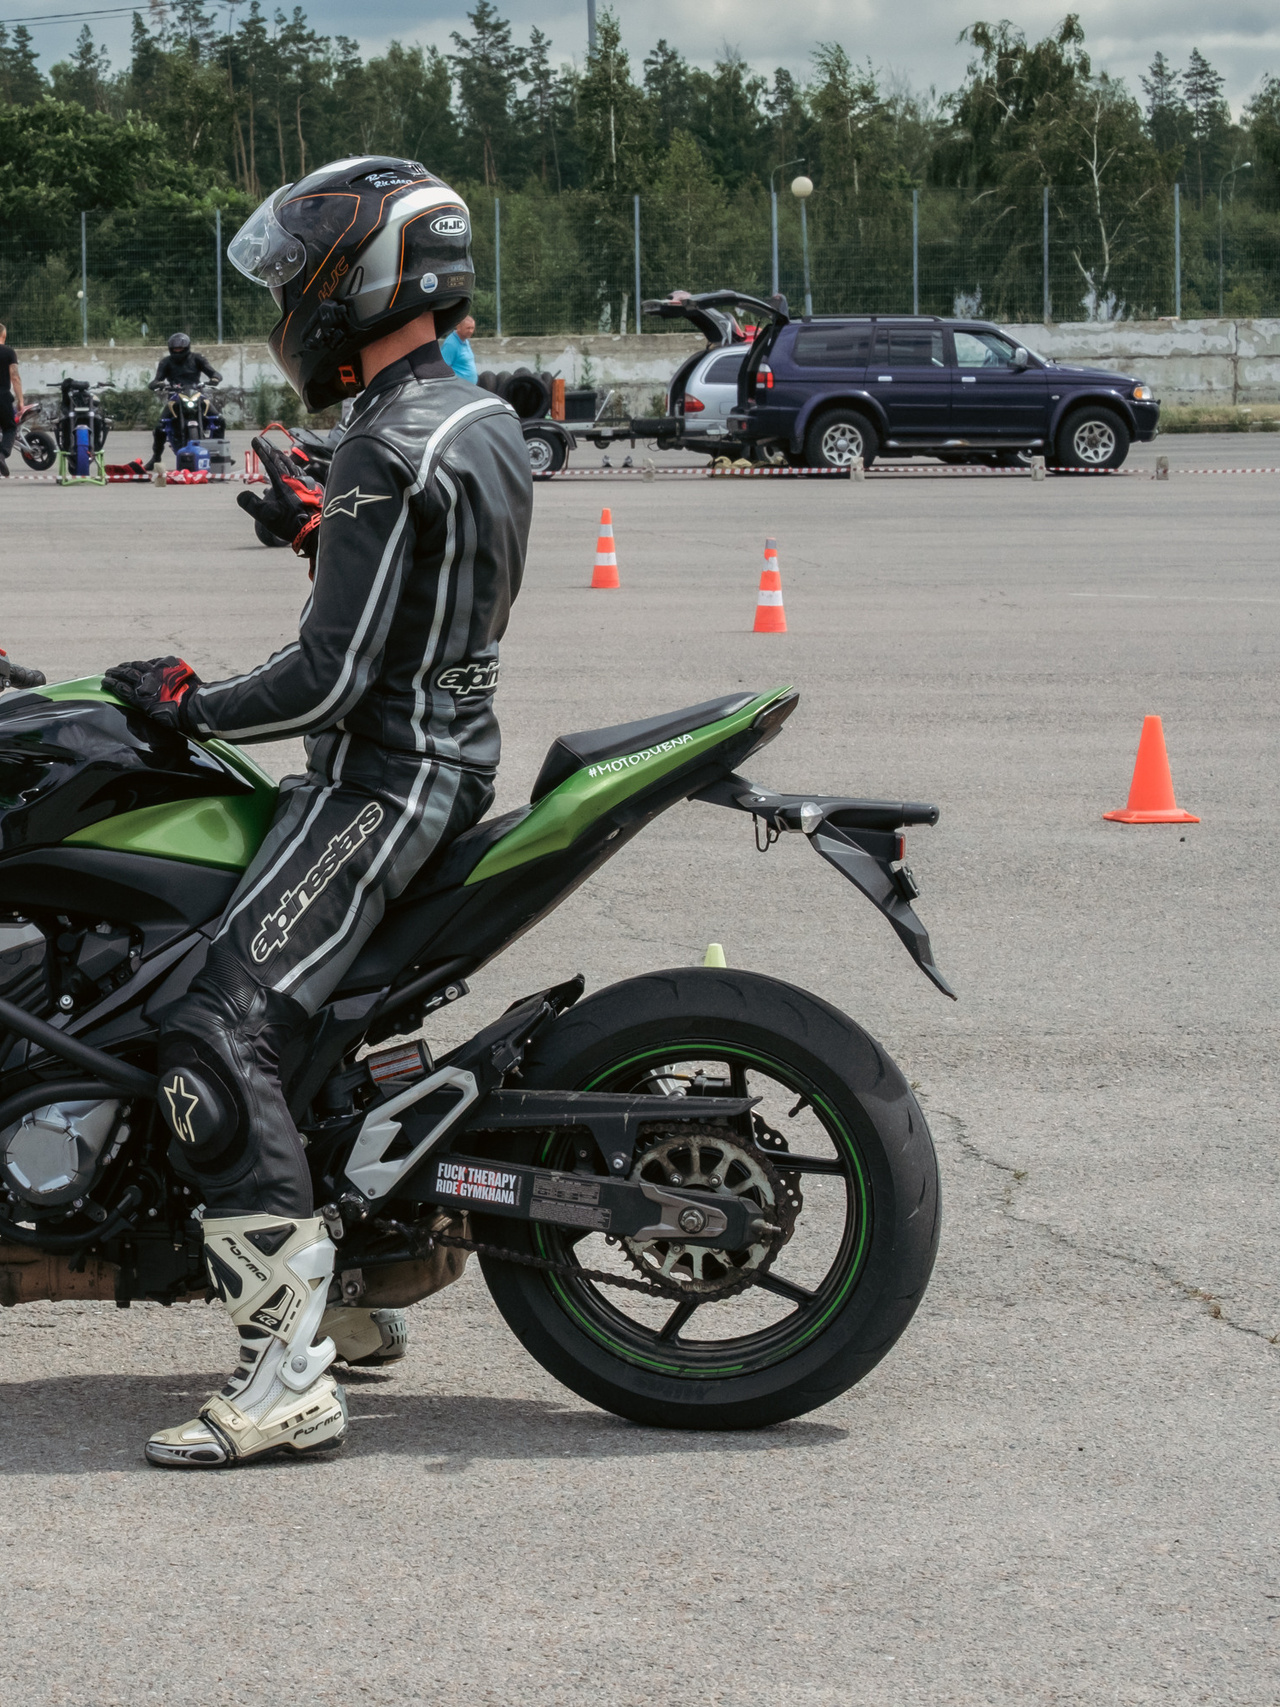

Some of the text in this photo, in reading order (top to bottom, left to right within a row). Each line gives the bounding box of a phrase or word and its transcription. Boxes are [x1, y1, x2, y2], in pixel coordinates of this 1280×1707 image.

[439, 220, 463, 231] HJC
[318, 255, 349, 304] HJC
[588, 734, 694, 778] #MOTODUBNA
[251, 802, 384, 963] alpinestars
[435, 1178, 459, 1196] RIDE
[459, 1181, 515, 1206] GYMKHANA
[437, 1162, 466, 1182] FUCK
[468, 1167, 517, 1190] THERAPY
